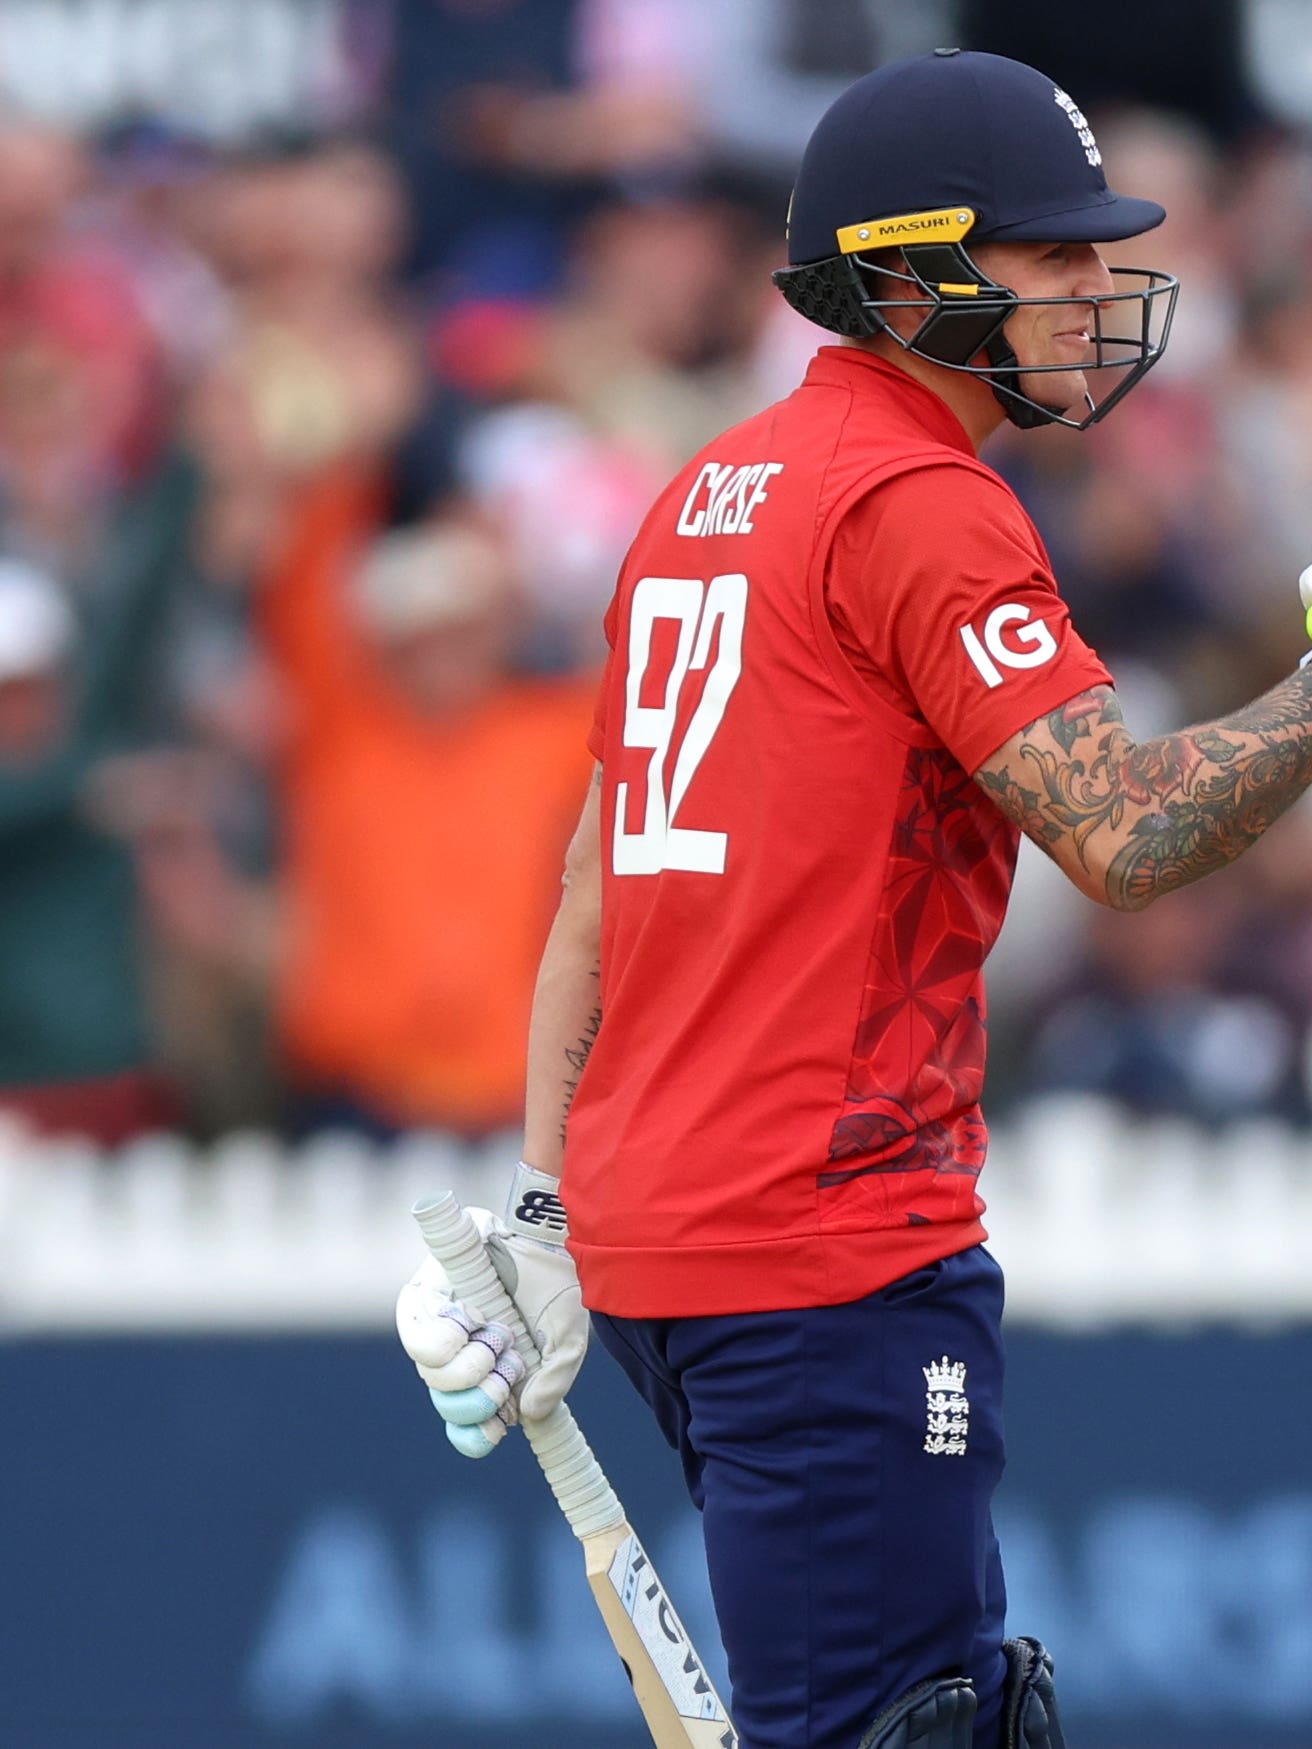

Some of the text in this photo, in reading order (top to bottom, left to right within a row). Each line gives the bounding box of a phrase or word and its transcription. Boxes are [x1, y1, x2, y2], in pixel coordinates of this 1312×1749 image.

[879, 216, 950, 236] MASURI
[676, 461, 784, 538] CARSE
[960, 603, 1058, 689] IG
[612, 573, 748, 876] 92
